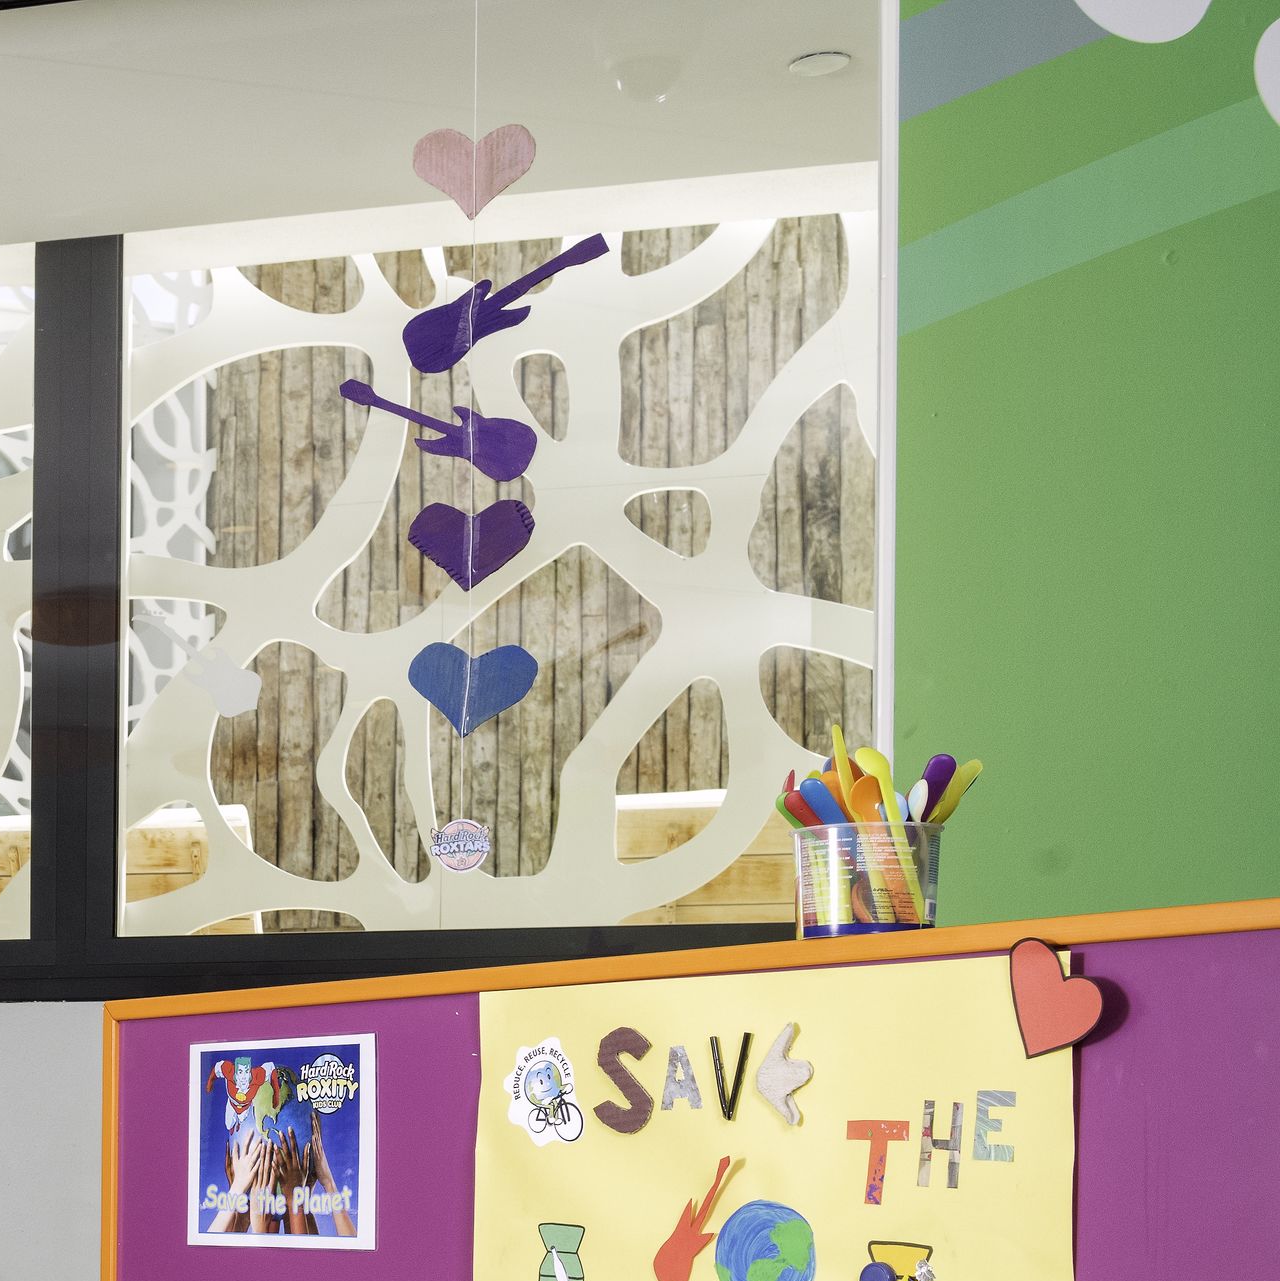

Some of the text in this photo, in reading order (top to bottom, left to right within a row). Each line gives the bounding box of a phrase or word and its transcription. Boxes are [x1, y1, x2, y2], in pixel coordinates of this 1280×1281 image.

[435, 831, 460, 843] Hard
[300, 1061, 355, 1081] Hard Rock
[549, 1048, 571, 1078] RECYCLE
[297, 1079, 359, 1102] ROXITY
[846, 1090, 1017, 1205] THE
[206, 1184, 353, 1215] Save the Planet
